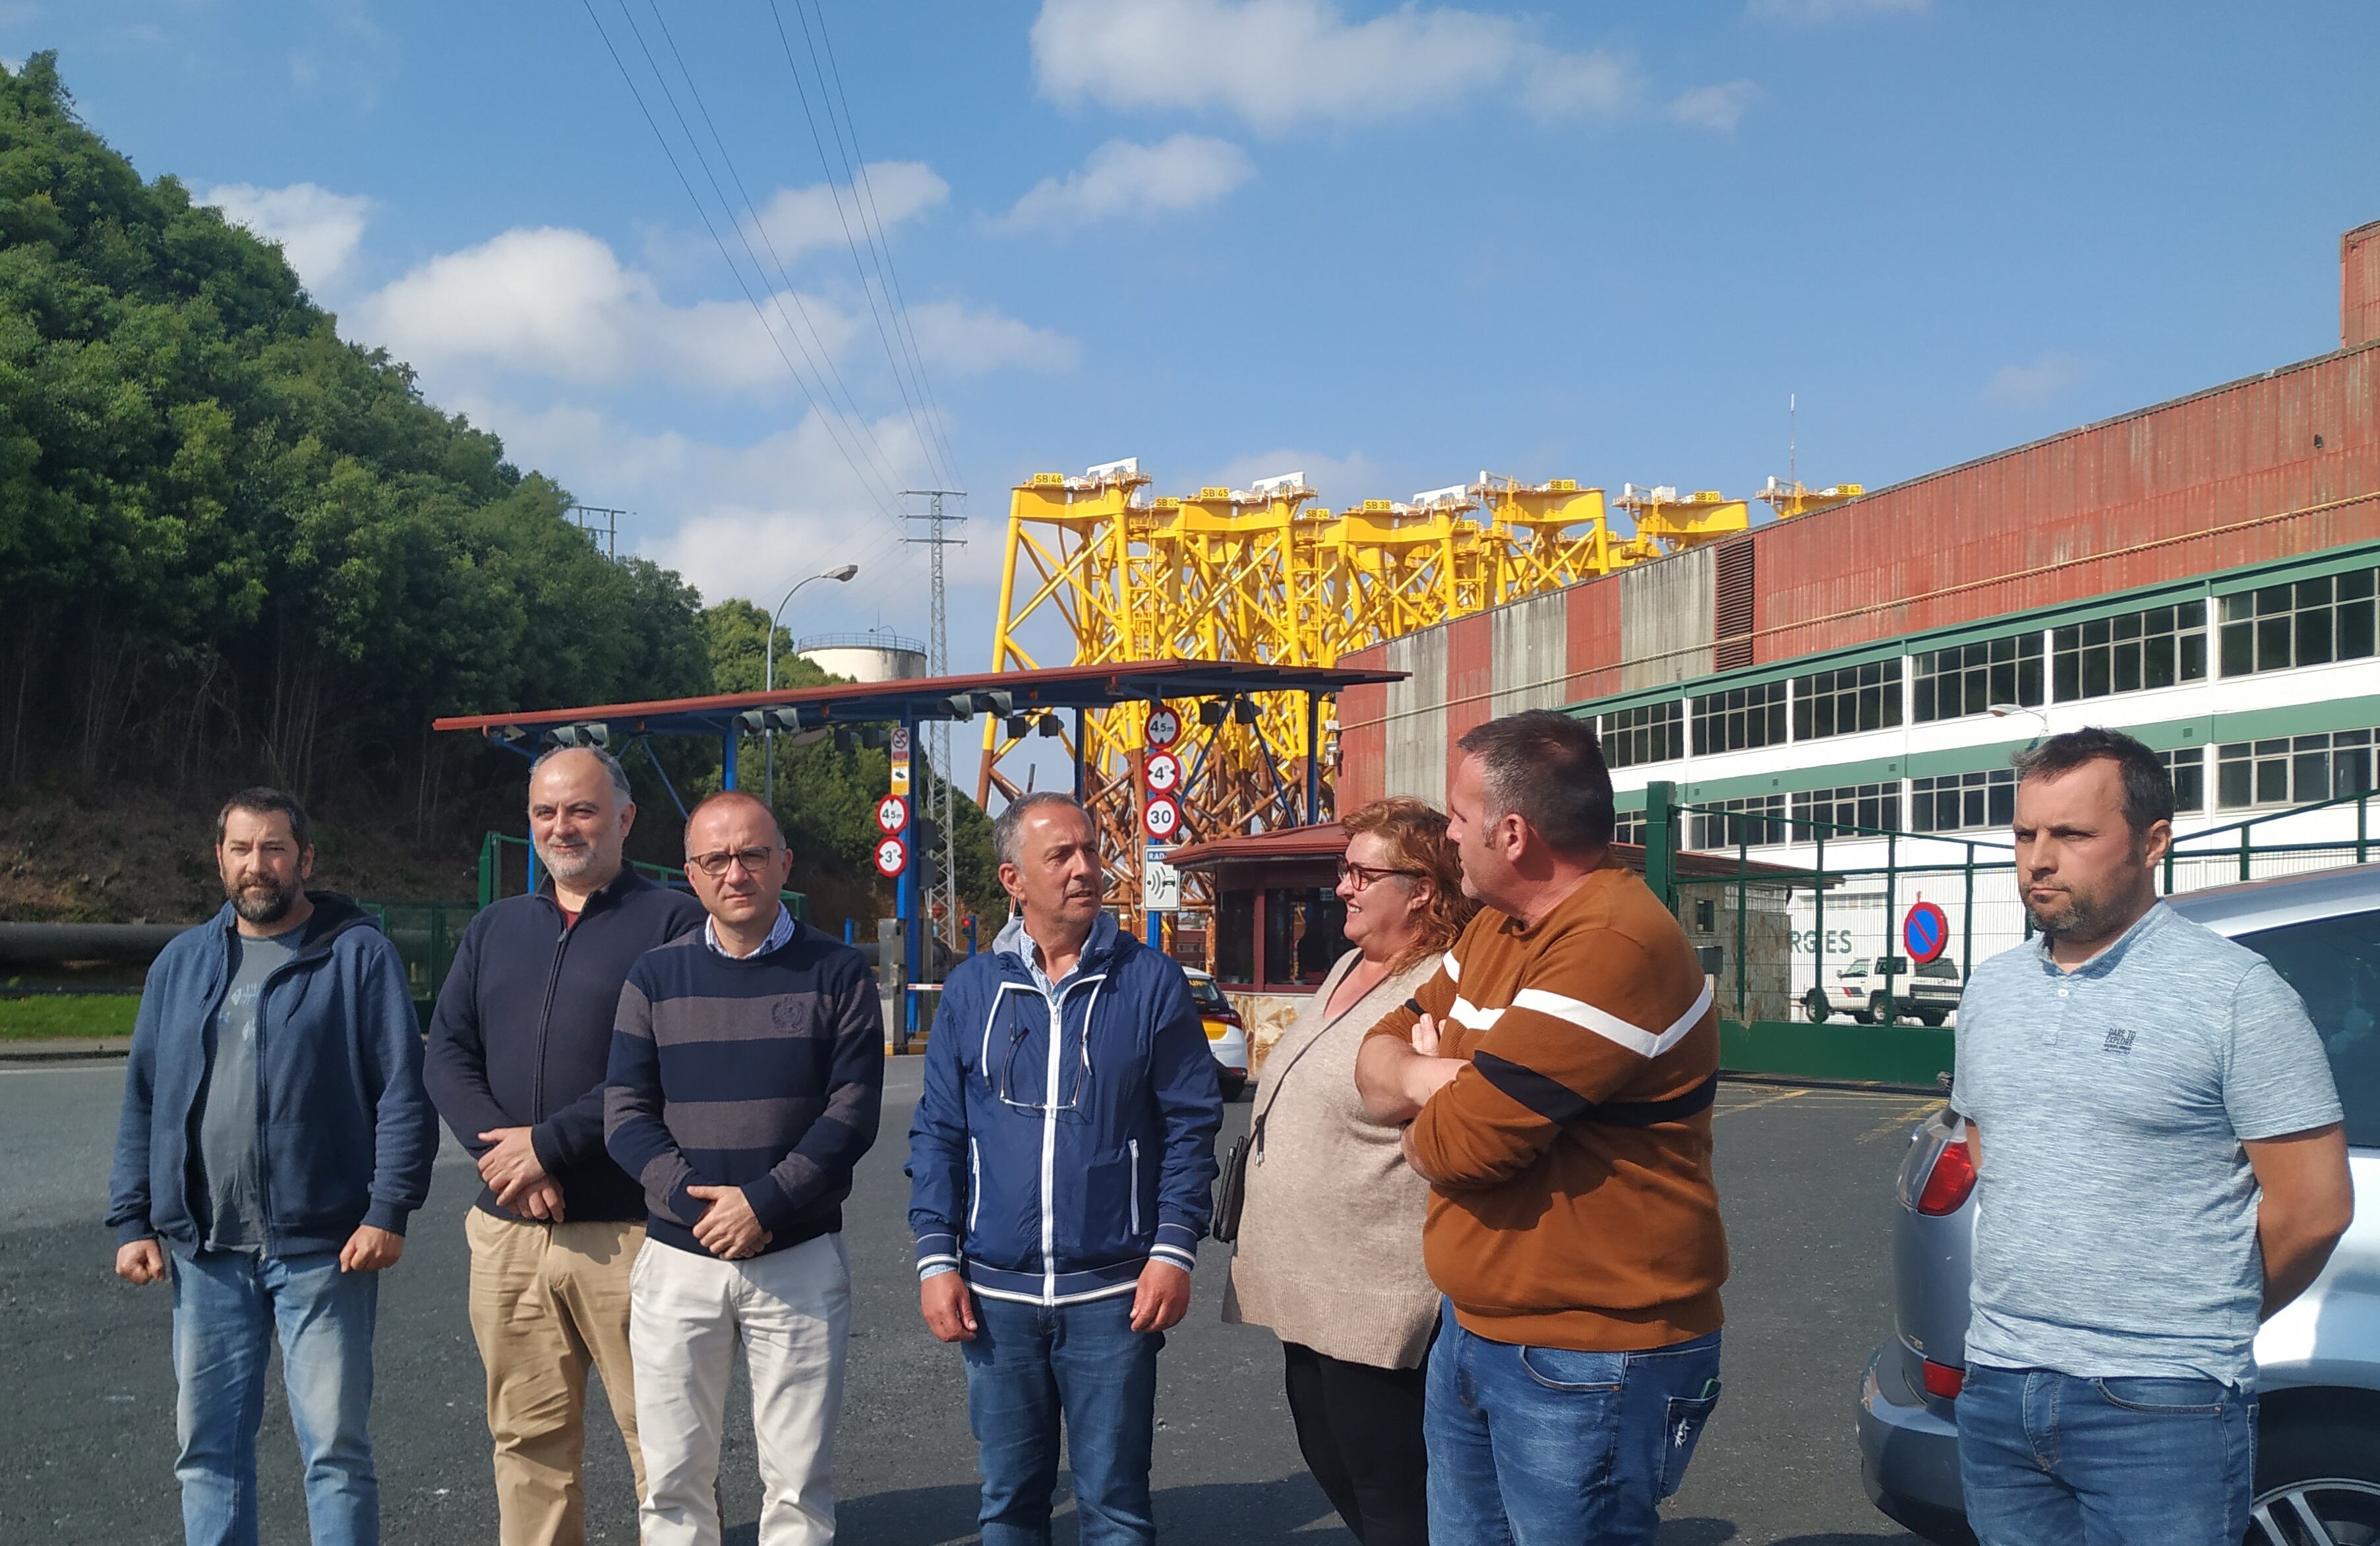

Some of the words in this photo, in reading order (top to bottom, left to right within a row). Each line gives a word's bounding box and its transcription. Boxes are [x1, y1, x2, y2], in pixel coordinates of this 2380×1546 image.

[1036, 475, 1048, 483] SB
[1051, 475, 1062, 483] 46
[1203, 489, 1214, 497] SB
[1218, 489, 1228, 497] 45
[1365, 501, 1377, 510] SB
[1150, 810, 1172, 824] 30
[1791, 930, 1852, 954] RGES
[2108, 1028, 2126, 1038] DARE
[2127, 1029, 2136, 1040] TO
[2105, 1035, 2133, 1047] EXPLORE
